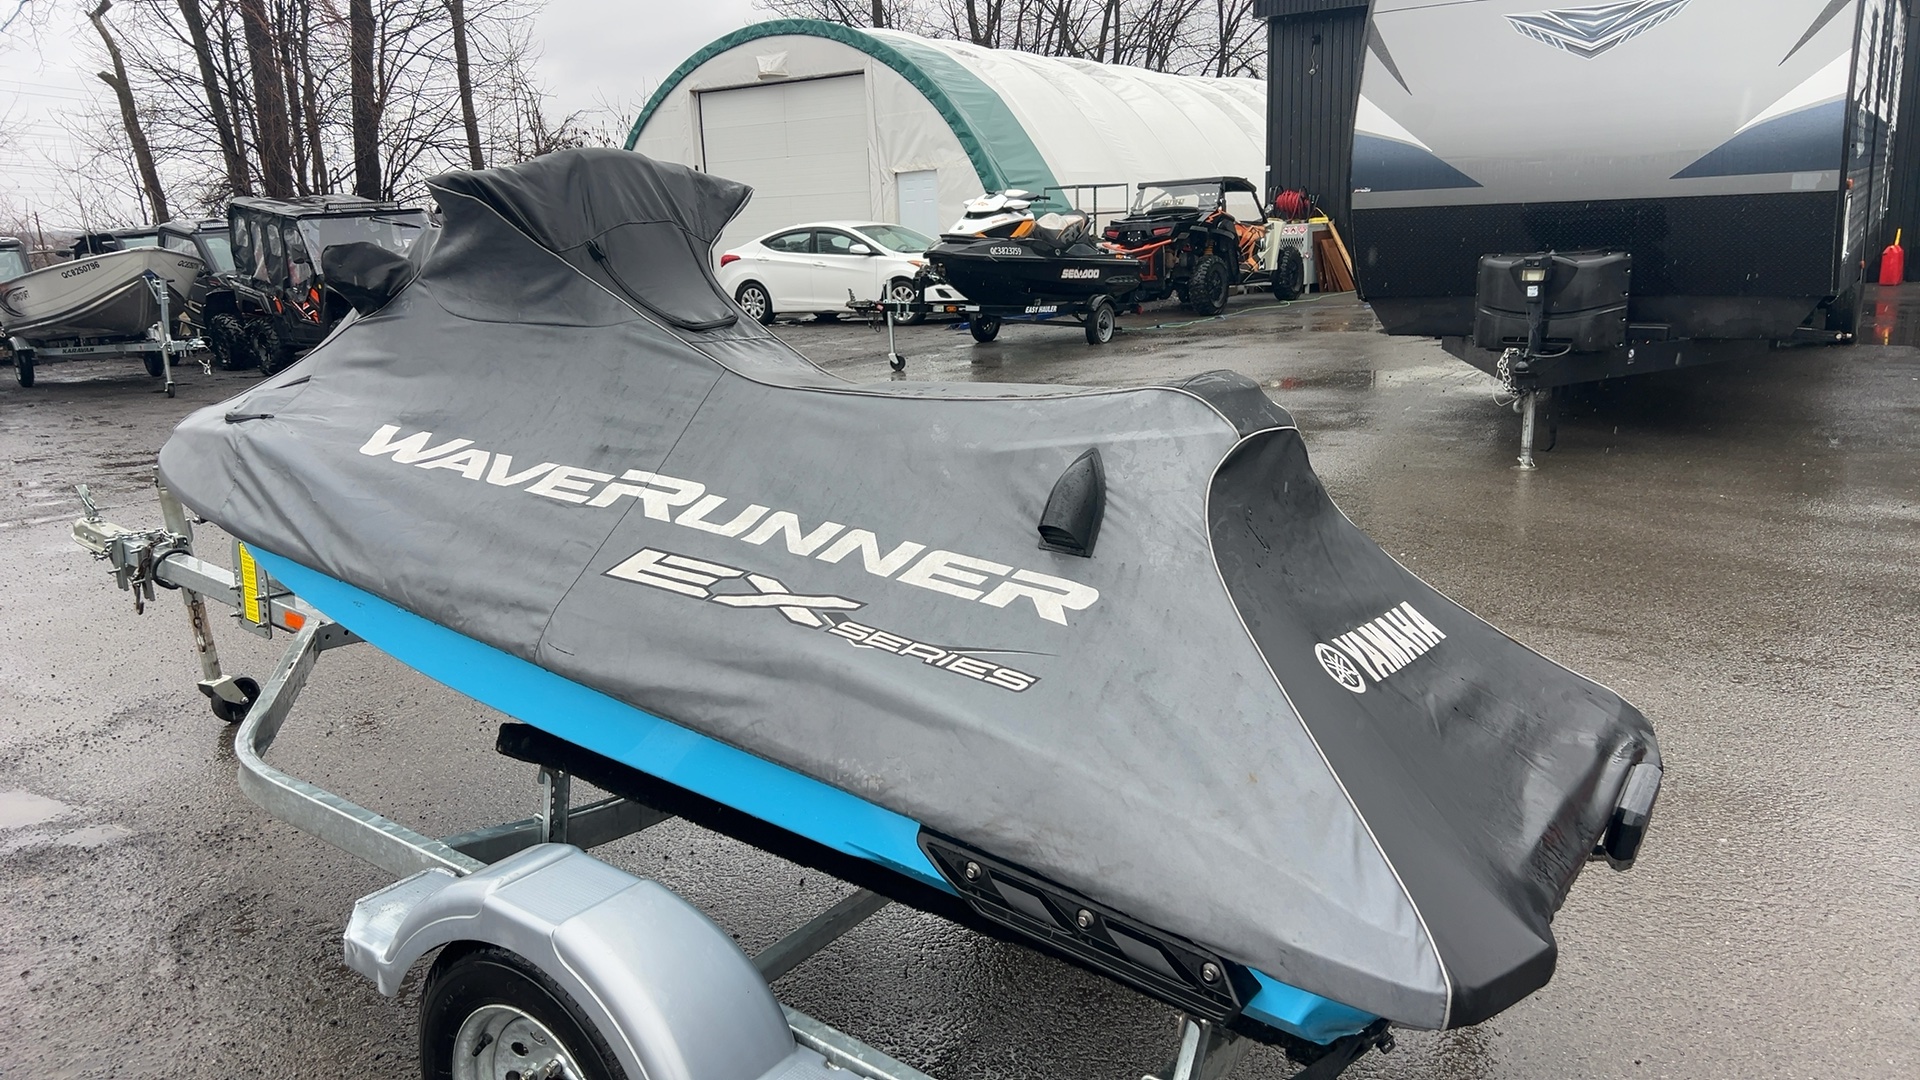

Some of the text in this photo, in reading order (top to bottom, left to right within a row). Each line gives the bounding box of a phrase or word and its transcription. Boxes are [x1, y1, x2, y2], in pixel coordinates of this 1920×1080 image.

[1025, 305, 1058, 314] EASY HAULER
[603, 547, 1041, 693] EX SERIES
[1331, 601, 1447, 682] YAMAHA
